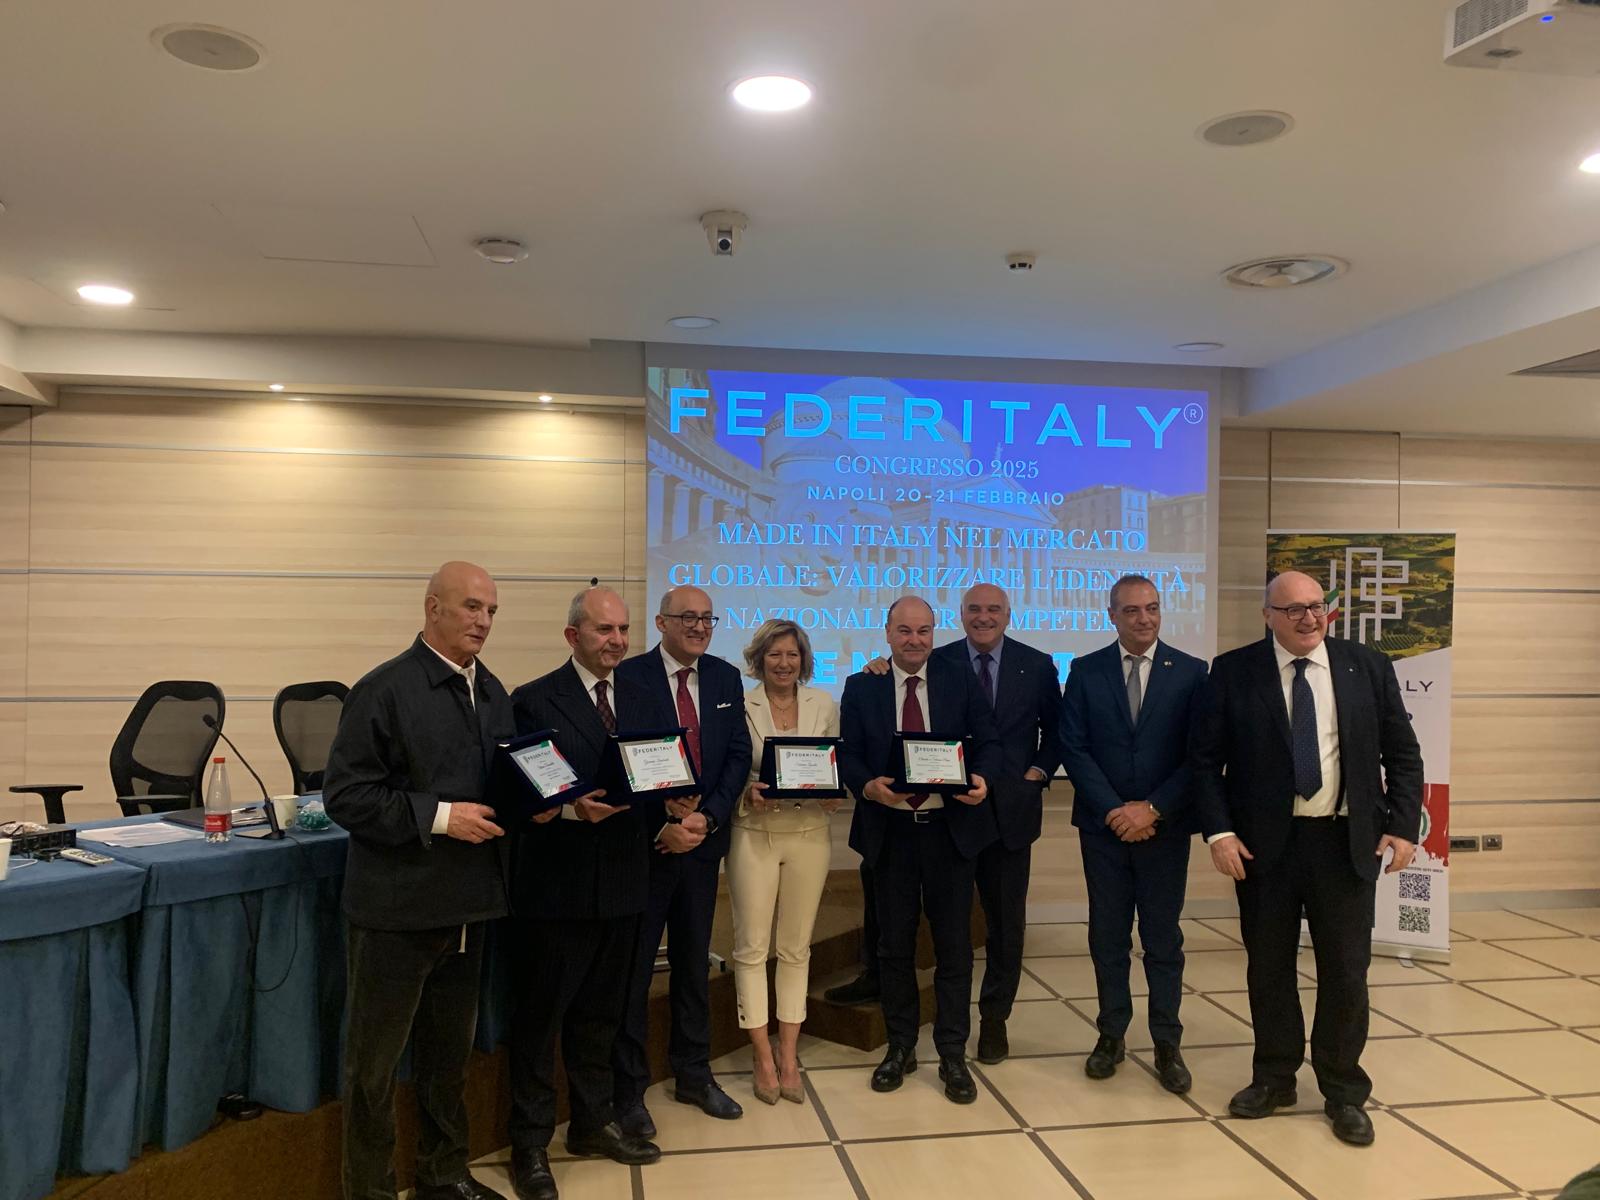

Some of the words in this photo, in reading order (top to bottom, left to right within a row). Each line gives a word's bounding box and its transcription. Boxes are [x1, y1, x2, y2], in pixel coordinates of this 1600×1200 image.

[834, 455, 984, 478] CONGRESSO
[990, 459, 1039, 480] 2025
[807, 486, 885, 502] NAPOLI
[895, 488, 954, 503] 20-21
[964, 490, 1065, 506] FEBBRAIO
[718, 522, 805, 546] MADE
[812, 524, 845, 546] IN
[851, 525, 938, 548] ITALY
[943, 527, 1001, 549] NEL
[1007, 528, 1146, 552] MERCATO
[668, 563, 818, 588] GLOBALE:
[826, 565, 1025, 590] VALORIZZARE
[1033, 565, 1191, 593] L'IDENTÀ
